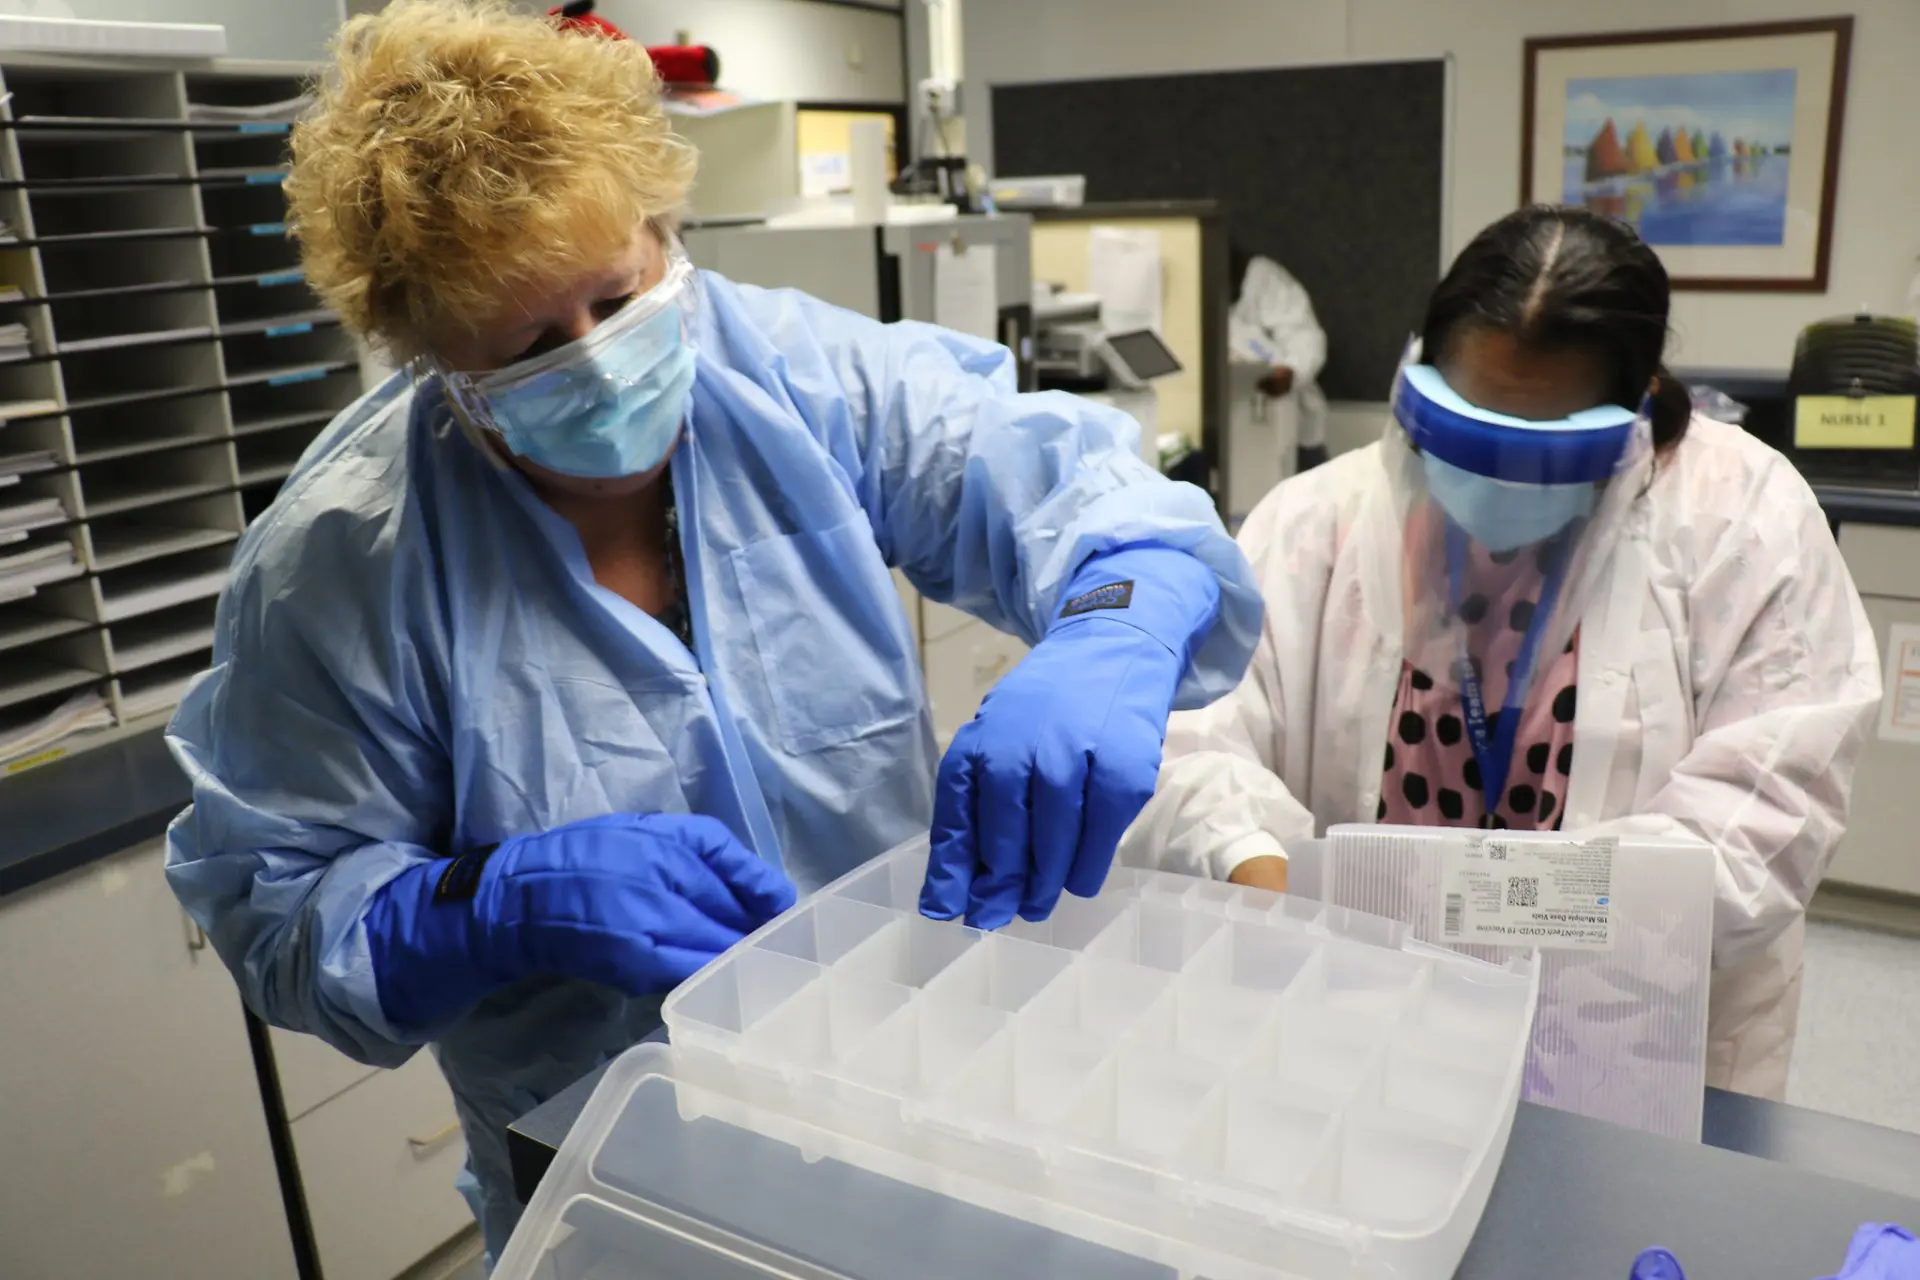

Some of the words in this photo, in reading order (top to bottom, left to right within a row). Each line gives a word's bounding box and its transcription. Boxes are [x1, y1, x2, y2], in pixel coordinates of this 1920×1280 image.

[1820, 412, 1872, 426] NURSE
[1877, 413, 1887, 426] 1
[1467, 682, 1484, 725] Team
[1550, 914, 1567, 922] Dose
[1567, 914, 1596, 923] Multiple
[1476, 924, 1506, 934] Vaccine
[1507, 926, 1546, 936] COVID-19
